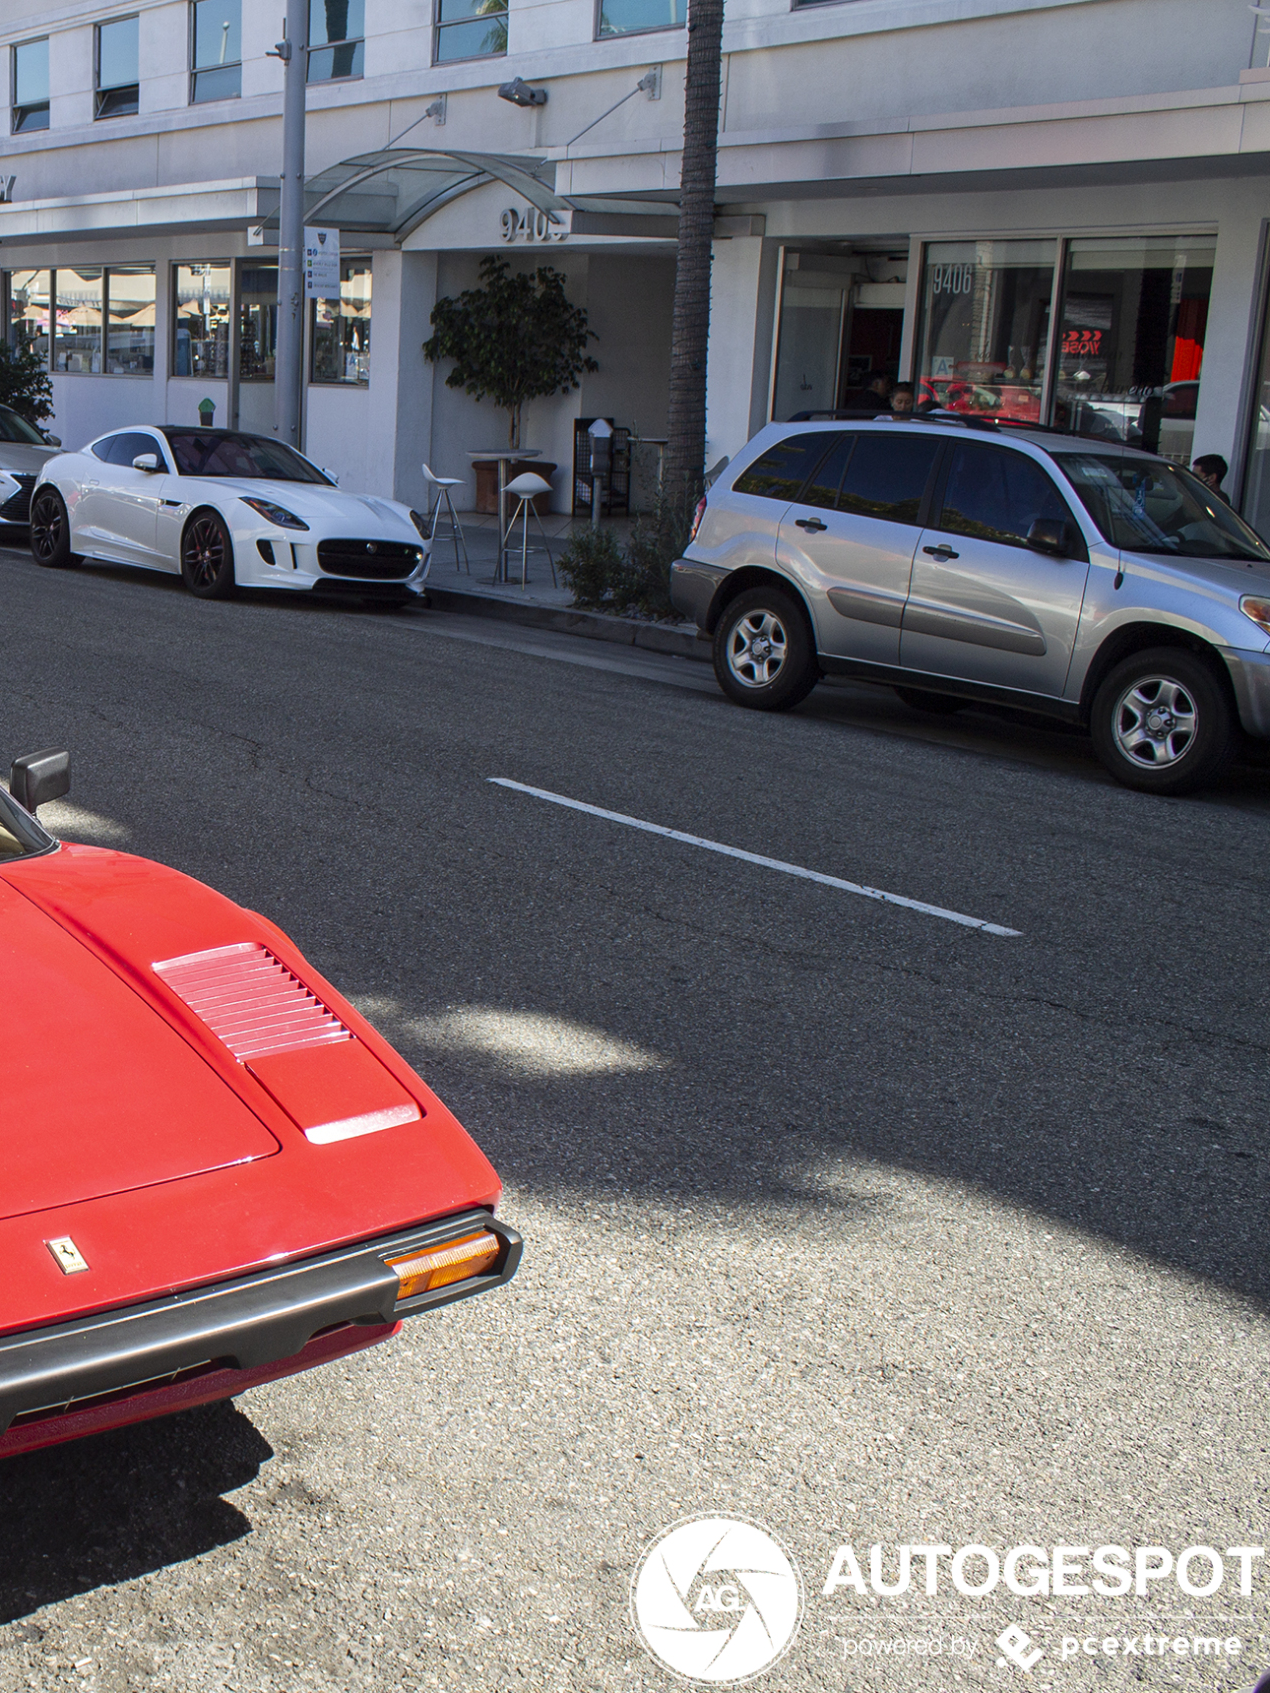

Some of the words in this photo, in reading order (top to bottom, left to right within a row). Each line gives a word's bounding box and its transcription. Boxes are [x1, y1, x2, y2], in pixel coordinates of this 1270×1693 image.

[500, 206, 566, 243] 940
[933, 263, 972, 294] 9406
[936, 358, 948, 375] A
